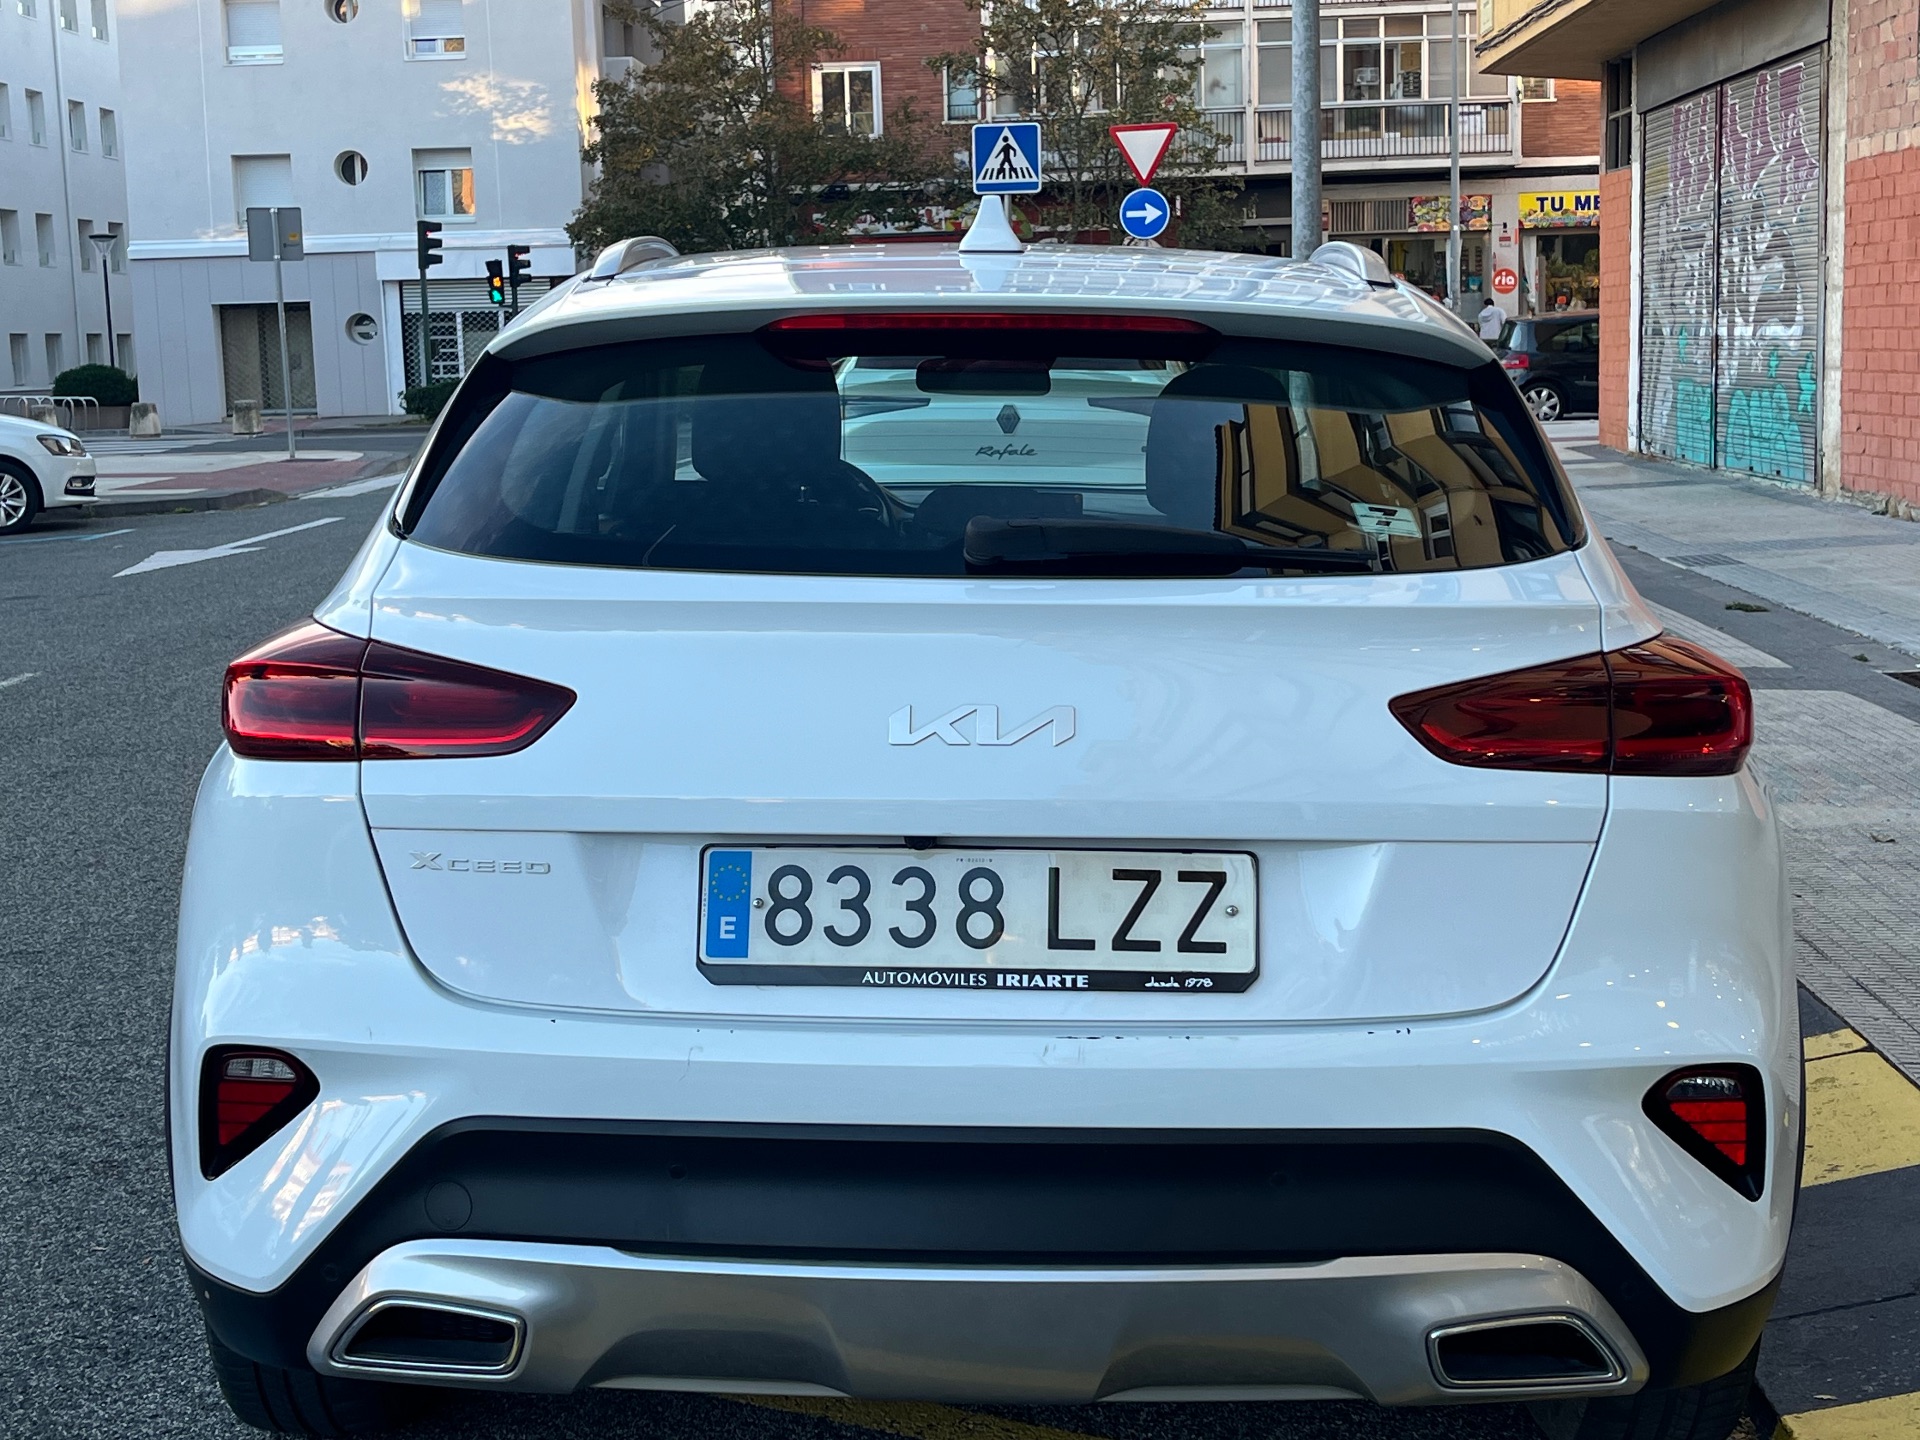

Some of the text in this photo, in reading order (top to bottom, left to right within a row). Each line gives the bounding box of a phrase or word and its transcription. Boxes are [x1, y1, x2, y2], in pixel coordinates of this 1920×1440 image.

[1536, 196, 1564, 212] TU
[1494, 271, 1515, 286] ria
[975, 443, 1038, 460] Rafale
[888, 703, 1076, 747] KIA
[764, 864, 1227, 954] 8338 LZZ
[719, 916, 737, 939] E
[862, 971, 987, 987] AUTOMÓVILES
[997, 974, 1089, 988] IRIARTE
[1184, 977, 1213, 988] 1978
